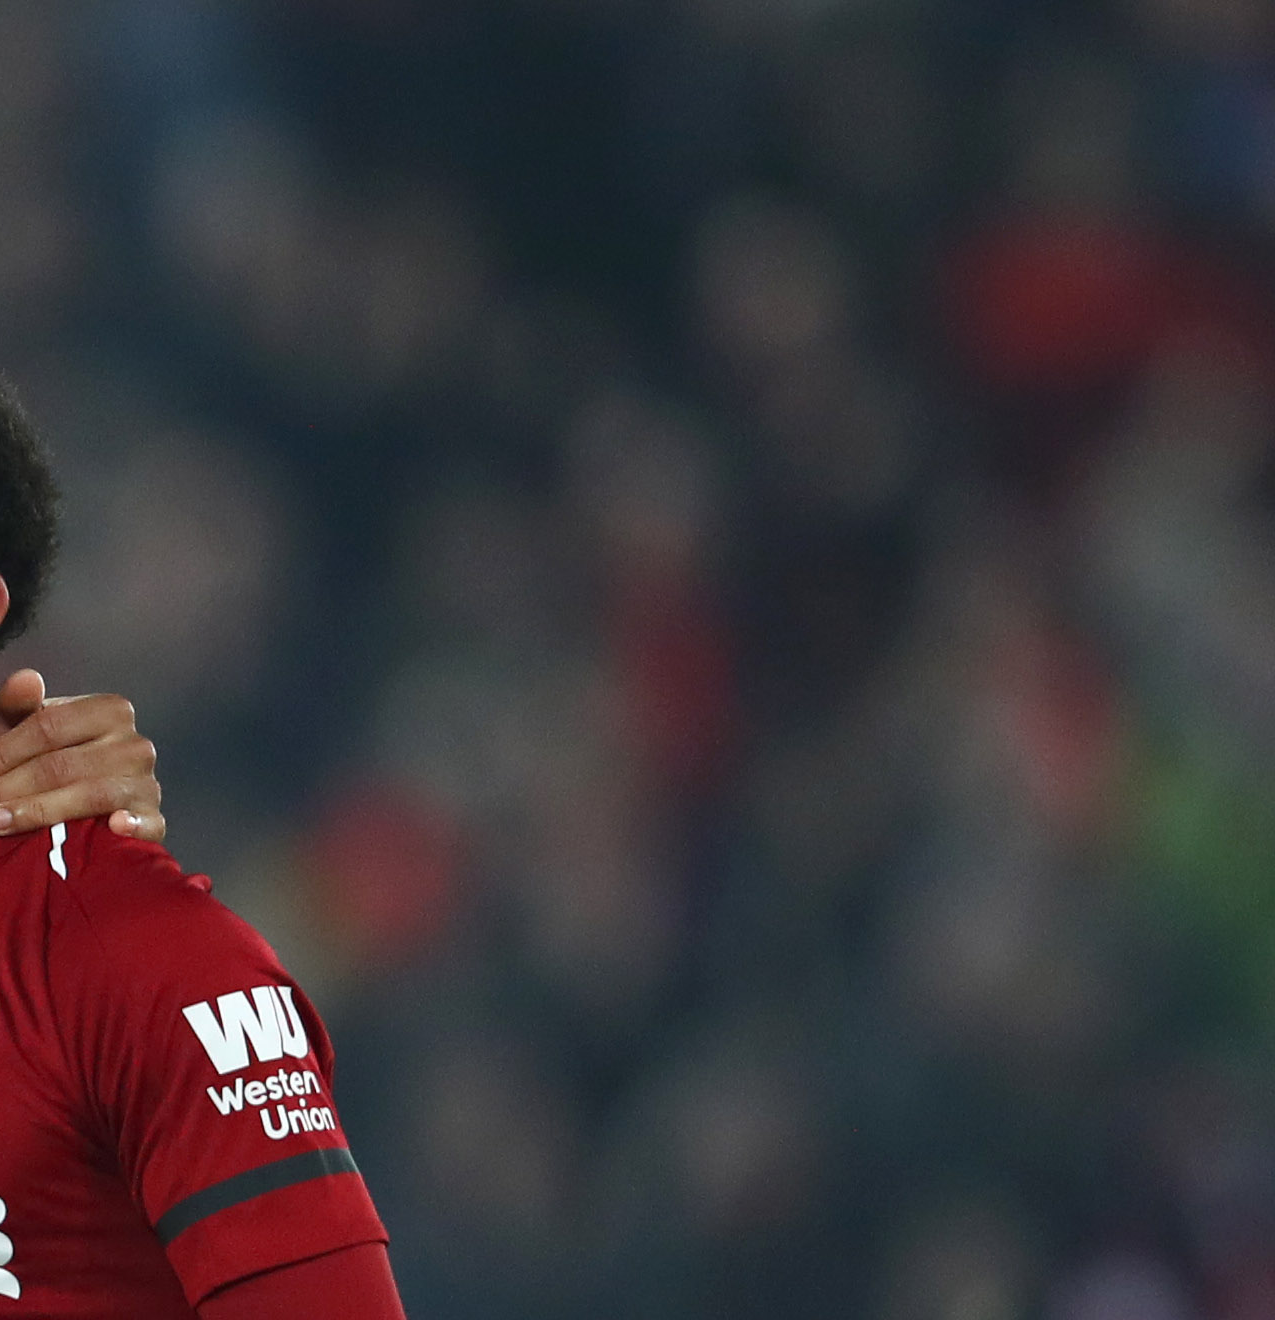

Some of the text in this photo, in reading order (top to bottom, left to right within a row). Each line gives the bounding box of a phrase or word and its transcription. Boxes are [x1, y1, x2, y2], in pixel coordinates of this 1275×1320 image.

[182, 986, 308, 1075] WU
[207, 1069, 321, 1116] Westen
[260, 1098, 336, 1140] Union
